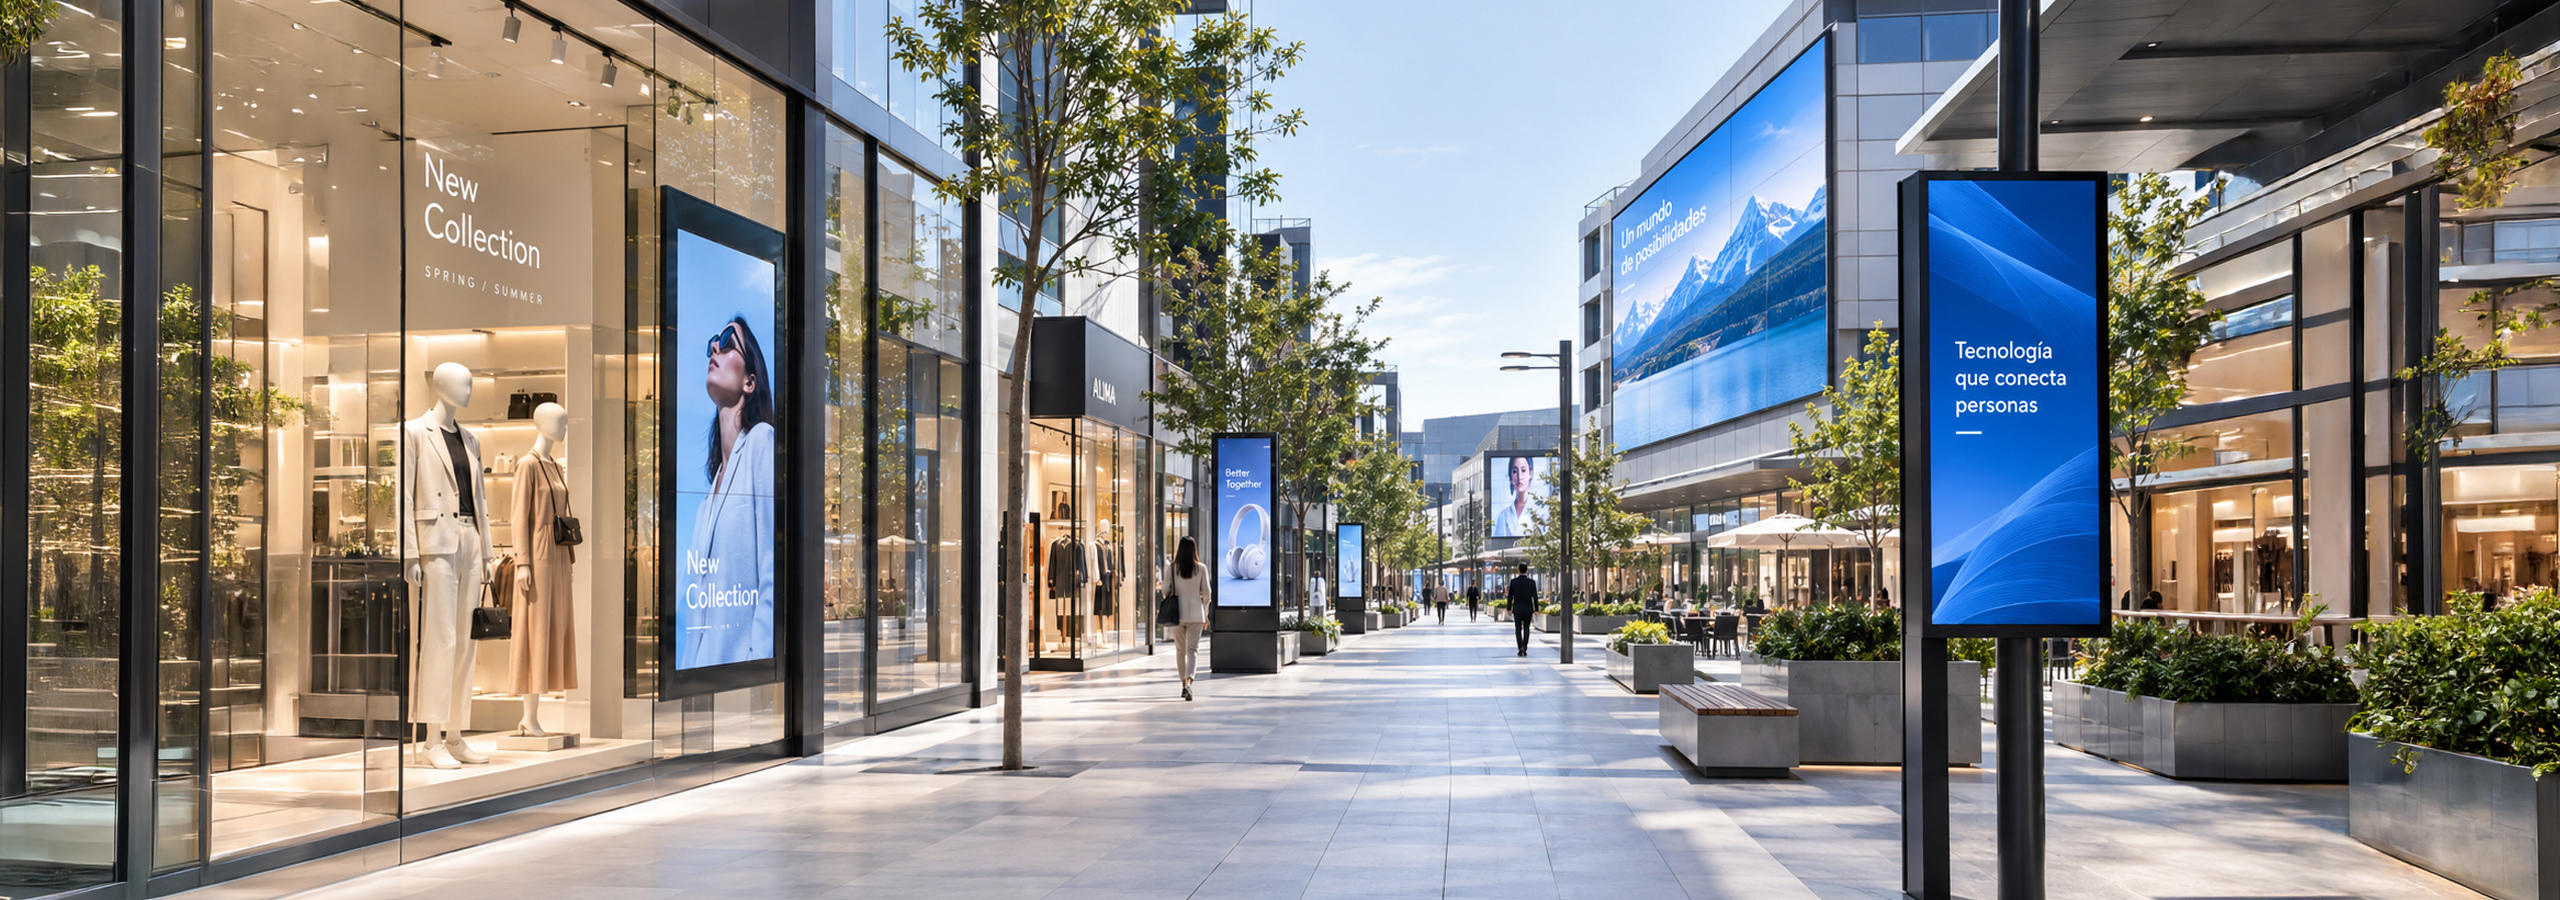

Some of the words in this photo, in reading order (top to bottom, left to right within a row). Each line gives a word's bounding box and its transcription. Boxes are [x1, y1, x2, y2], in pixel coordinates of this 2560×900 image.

[425, 152, 479, 203] New
[424, 202, 541, 269] Collection
[1621, 227, 1635, 249] Un
[1637, 199, 1673, 239] mundo
[1621, 254, 1634, 276] de
[1635, 205, 1707, 271] posibilidades
[424, 265, 475, 289] SPRING
[481, 280, 487, 292] /
[494, 283, 543, 305] SUMMER
[1955, 341, 2053, 364] Tecnología
[1955, 373, 1990, 391] que
[1995, 370, 2067, 386] conecta
[1956, 400, 2038, 418] personas
[1225, 468, 1250, 478] Better
[1225, 479, 1262, 491] Together
[687, 549, 720, 575] New
[686, 583, 759, 610] Collection
